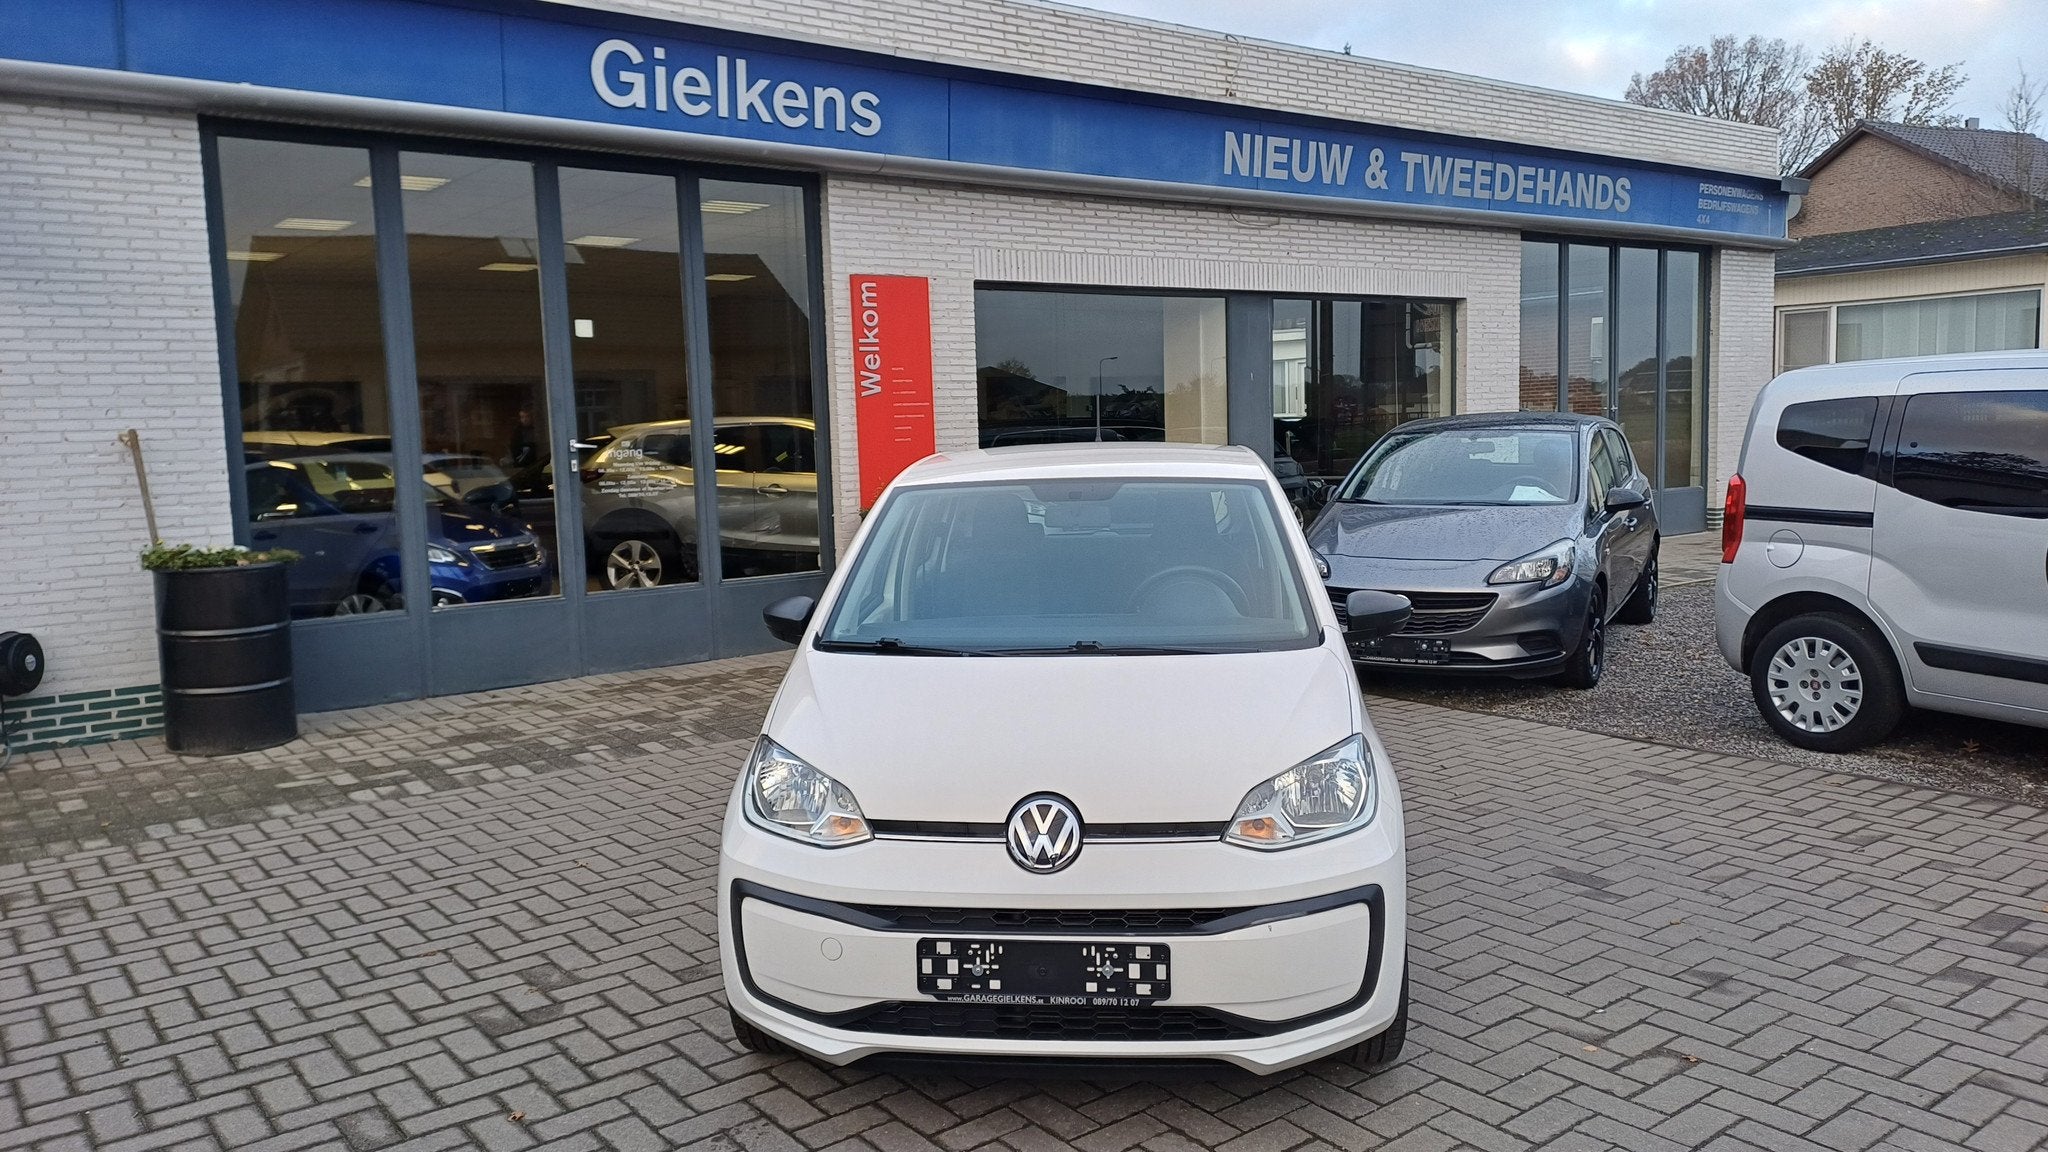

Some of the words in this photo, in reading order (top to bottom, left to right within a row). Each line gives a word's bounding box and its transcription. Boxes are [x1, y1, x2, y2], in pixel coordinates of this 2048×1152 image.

[590, 39, 881, 136] Gielkens
[1223, 131, 1353, 185] NIEUW
[1364, 148, 1388, 190] &
[1401, 152, 1631, 212] TWEEDEHANDS
[859, 282, 882, 397] Welkom
[1009, 800, 1079, 867] VW
[1050, 996, 1087, 1006] KINROOI
[1092, 997, 1118, 1007] 089/70
[1120, 998, 1129, 1007] 12
[1130, 998, 1140, 1007] 07
